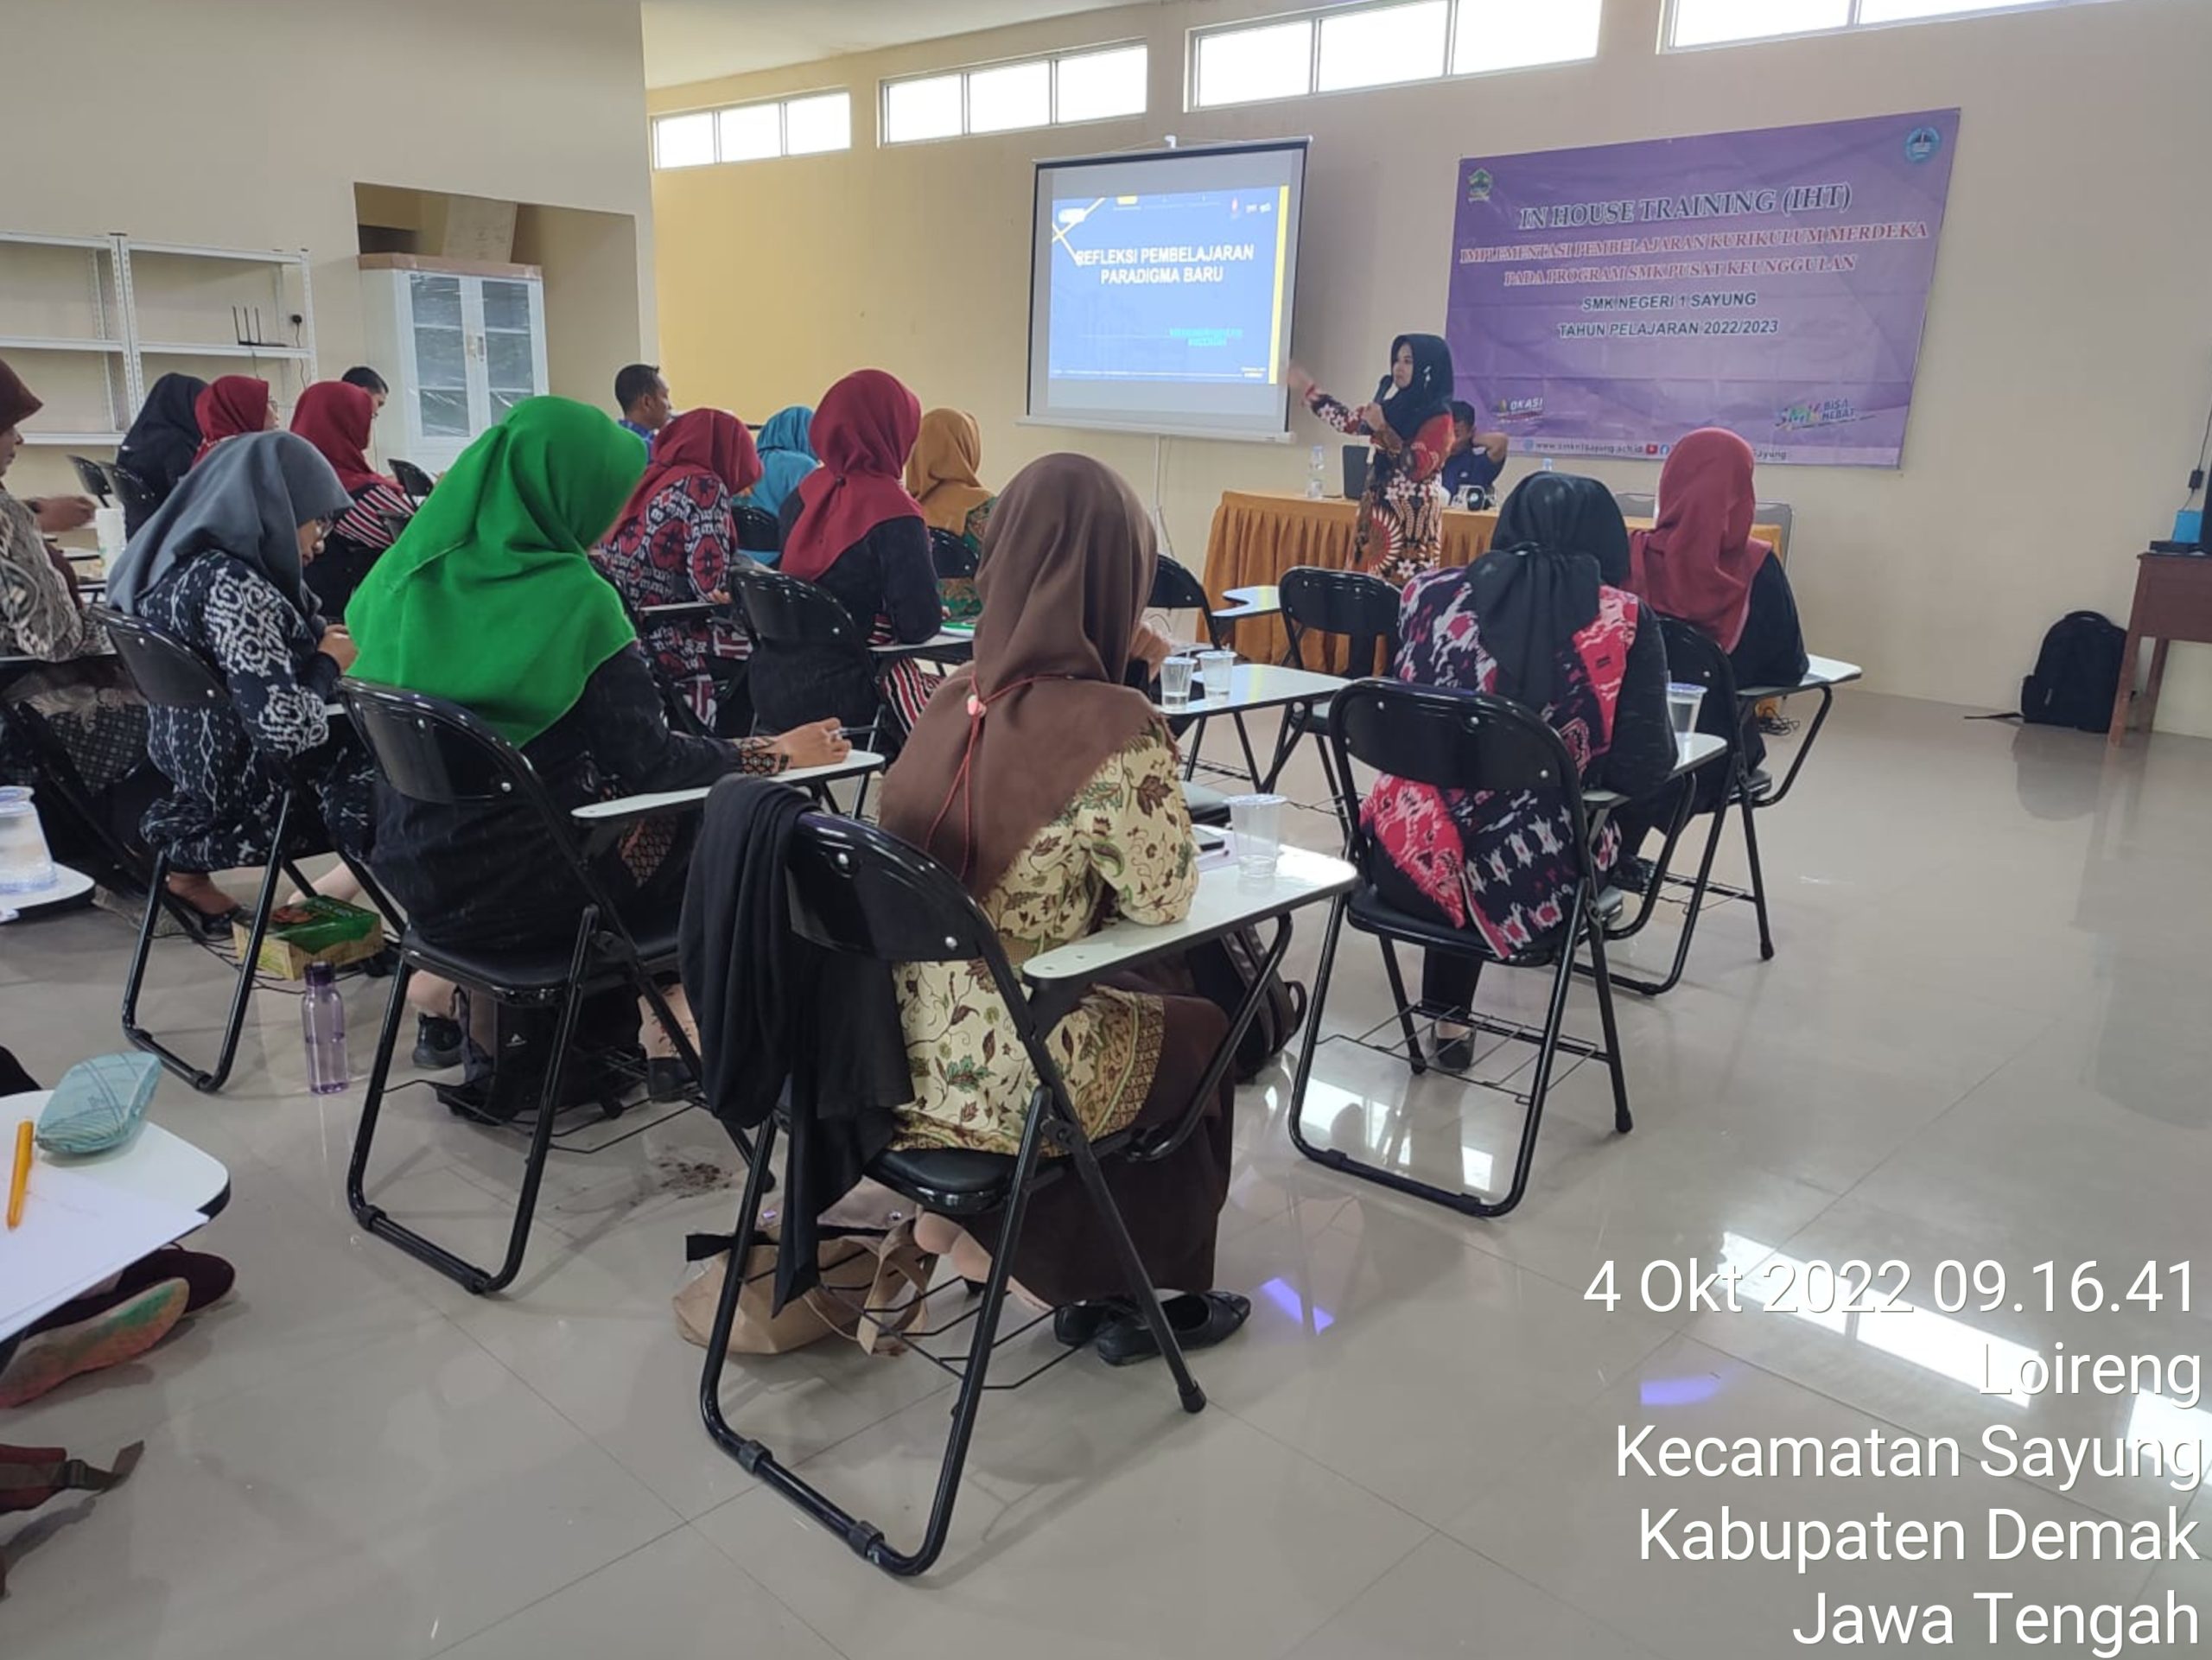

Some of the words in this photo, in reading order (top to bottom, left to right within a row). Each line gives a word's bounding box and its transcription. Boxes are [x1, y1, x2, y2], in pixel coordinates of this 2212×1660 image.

[1519, 207, 1548, 230] IN
[1549, 200, 1636, 228] HOUSE
[1639, 189, 1777, 223] TRAINING
[1781, 181, 1853, 216] (IHT)
[1574, 234, 1707, 258] PEMBELAJARAN
[1708, 227, 1824, 251] KURIKULUM
[1826, 221, 1929, 243] MERDEKA
[1077, 248, 1137, 265] REFLEKSI
[1141, 243, 1255, 264] PEMBELAJARAN
[1100, 266, 1179, 285] PARADIGMA
[1183, 265, 1224, 283] BARU
[1503, 270, 1545, 287] PADA
[1546, 266, 1625, 284] PROGRAM
[1626, 263, 1665, 283] SMK
[1667, 260, 1725, 280] PUSAT
[1726, 254, 1857, 277] KEUNGGULAN
[1582, 296, 1616, 312] SMK
[1618, 295, 1675, 311] NEGERI
[1678, 295, 1686, 309] 1
[1689, 291, 1758, 308] SAYUNG
[1558, 322, 1605, 339] TAHUN
[1608, 321, 1700, 337] PELAJARAN
[1702, 319, 1780, 335] 2022/2023
